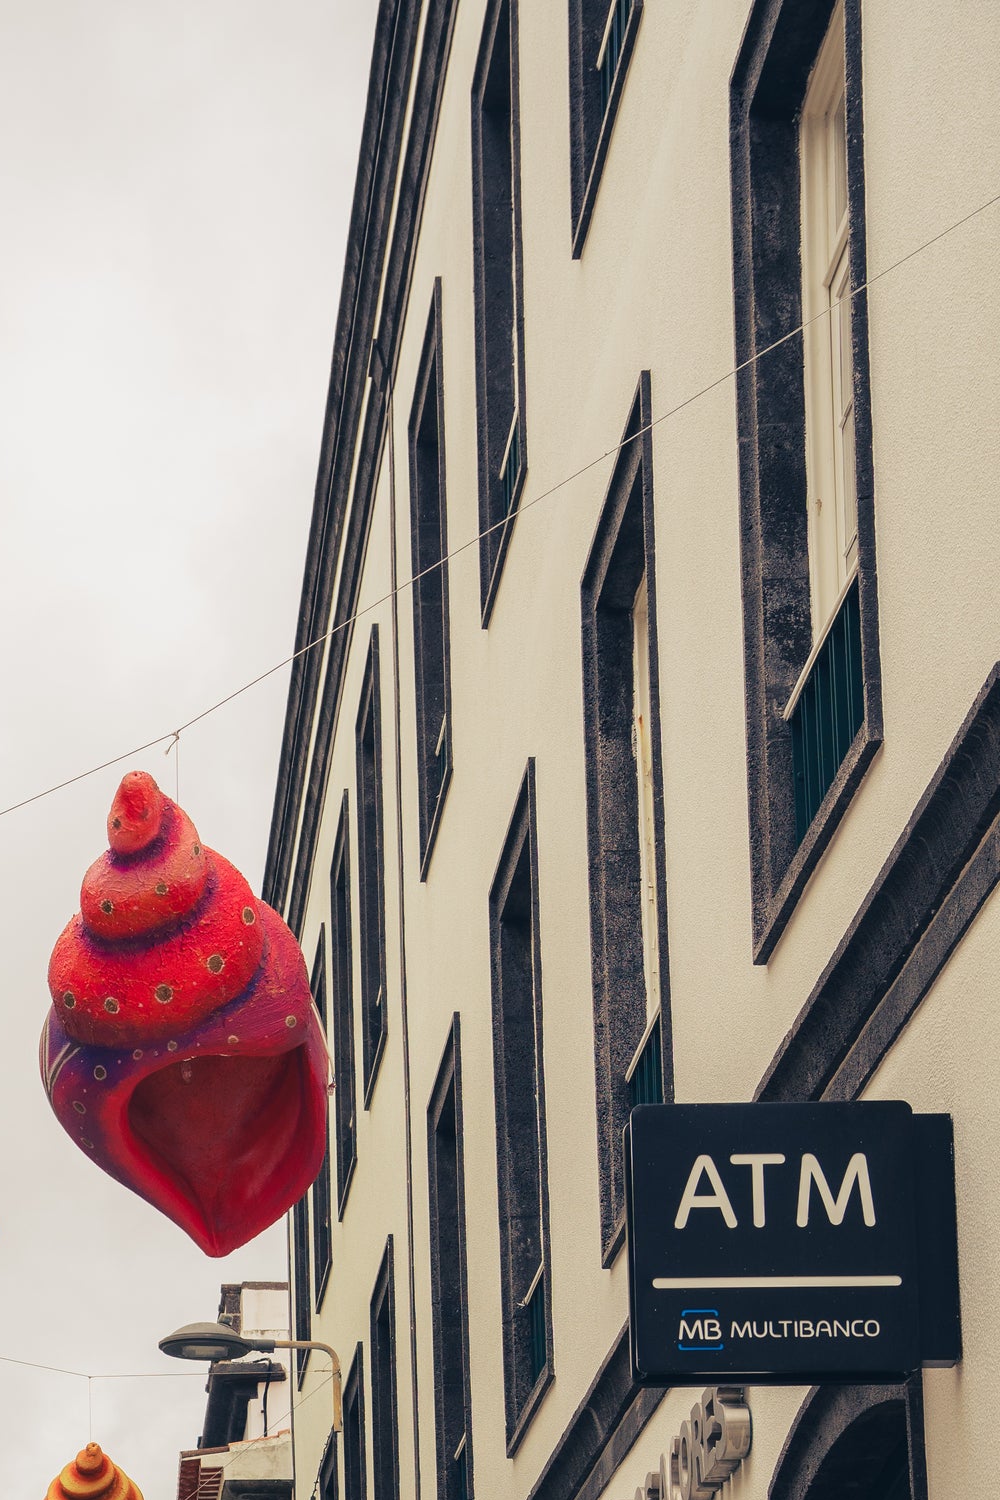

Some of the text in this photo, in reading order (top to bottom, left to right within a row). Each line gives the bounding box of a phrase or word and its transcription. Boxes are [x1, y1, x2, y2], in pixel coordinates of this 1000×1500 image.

[674, 1152, 876, 1229] ATM
[678, 1319, 881, 1340] MB MULTIBANCO
